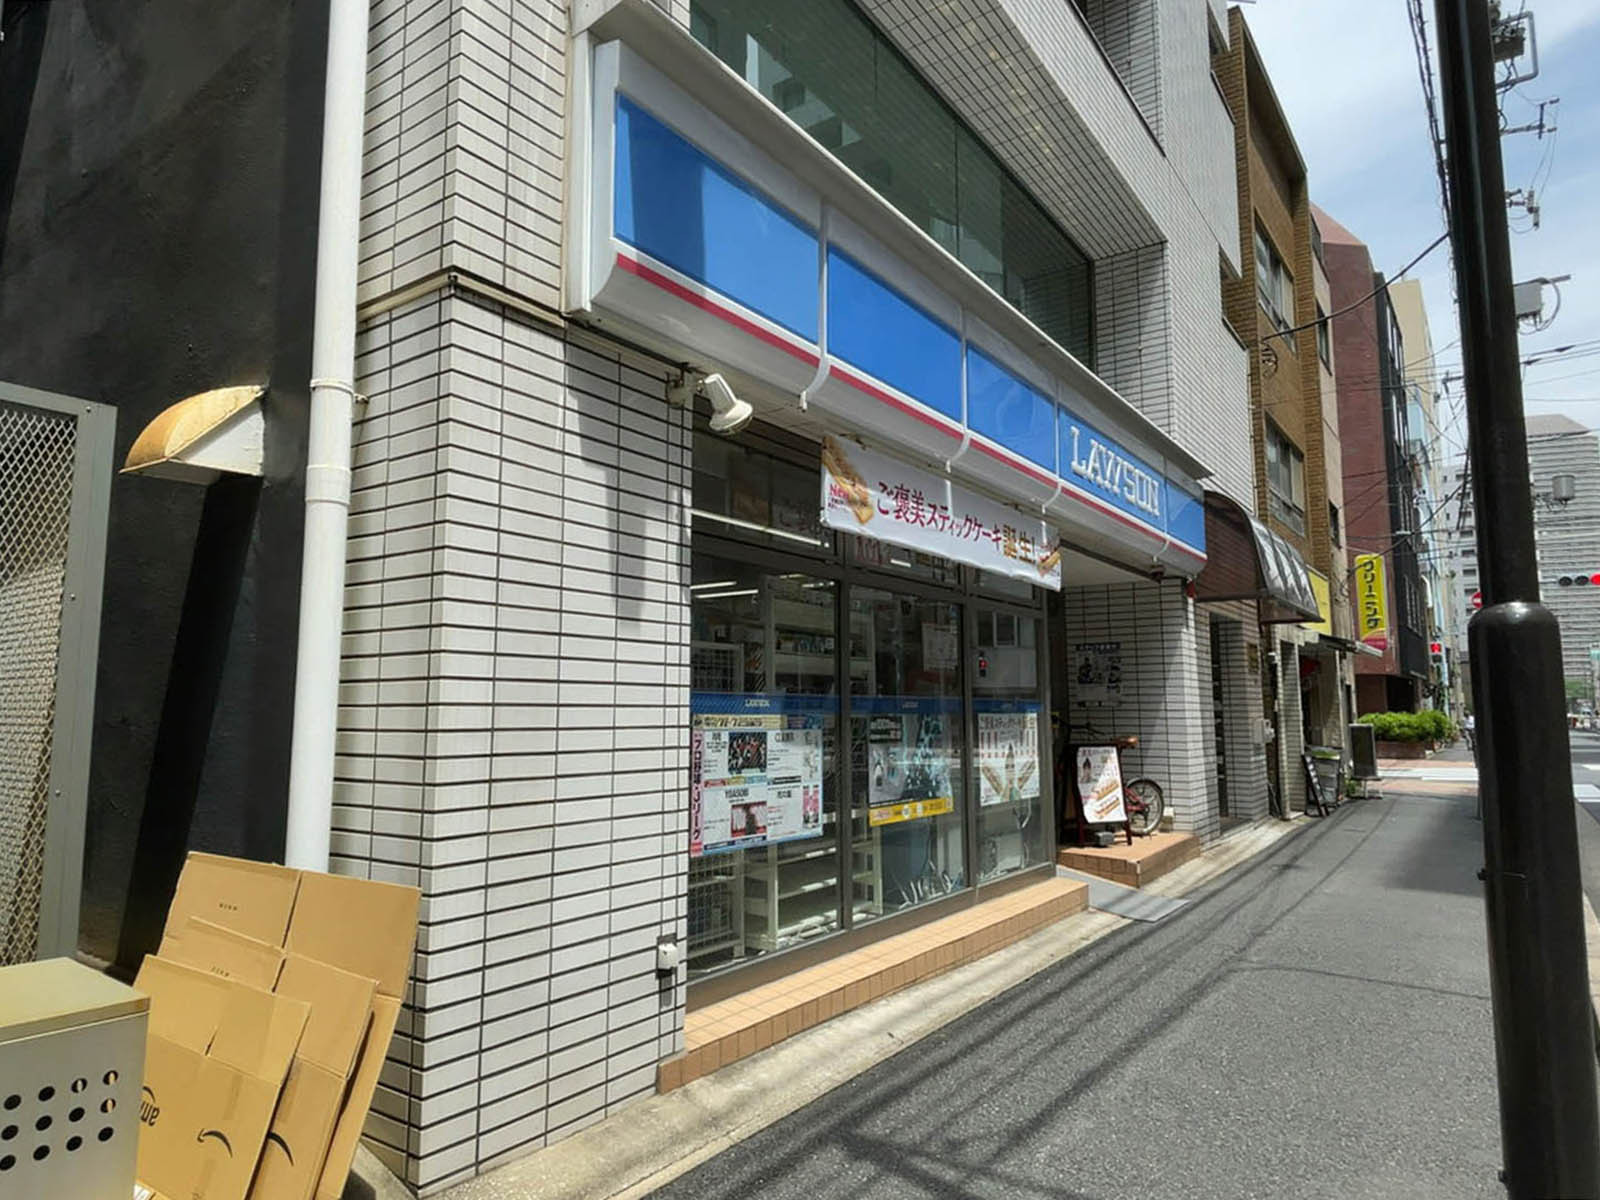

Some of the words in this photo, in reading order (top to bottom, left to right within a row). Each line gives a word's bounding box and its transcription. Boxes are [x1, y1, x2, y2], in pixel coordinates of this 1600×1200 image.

[1070, 425, 1160, 517] LAWSON
[1362, 559, 1381, 630] クリーニング
